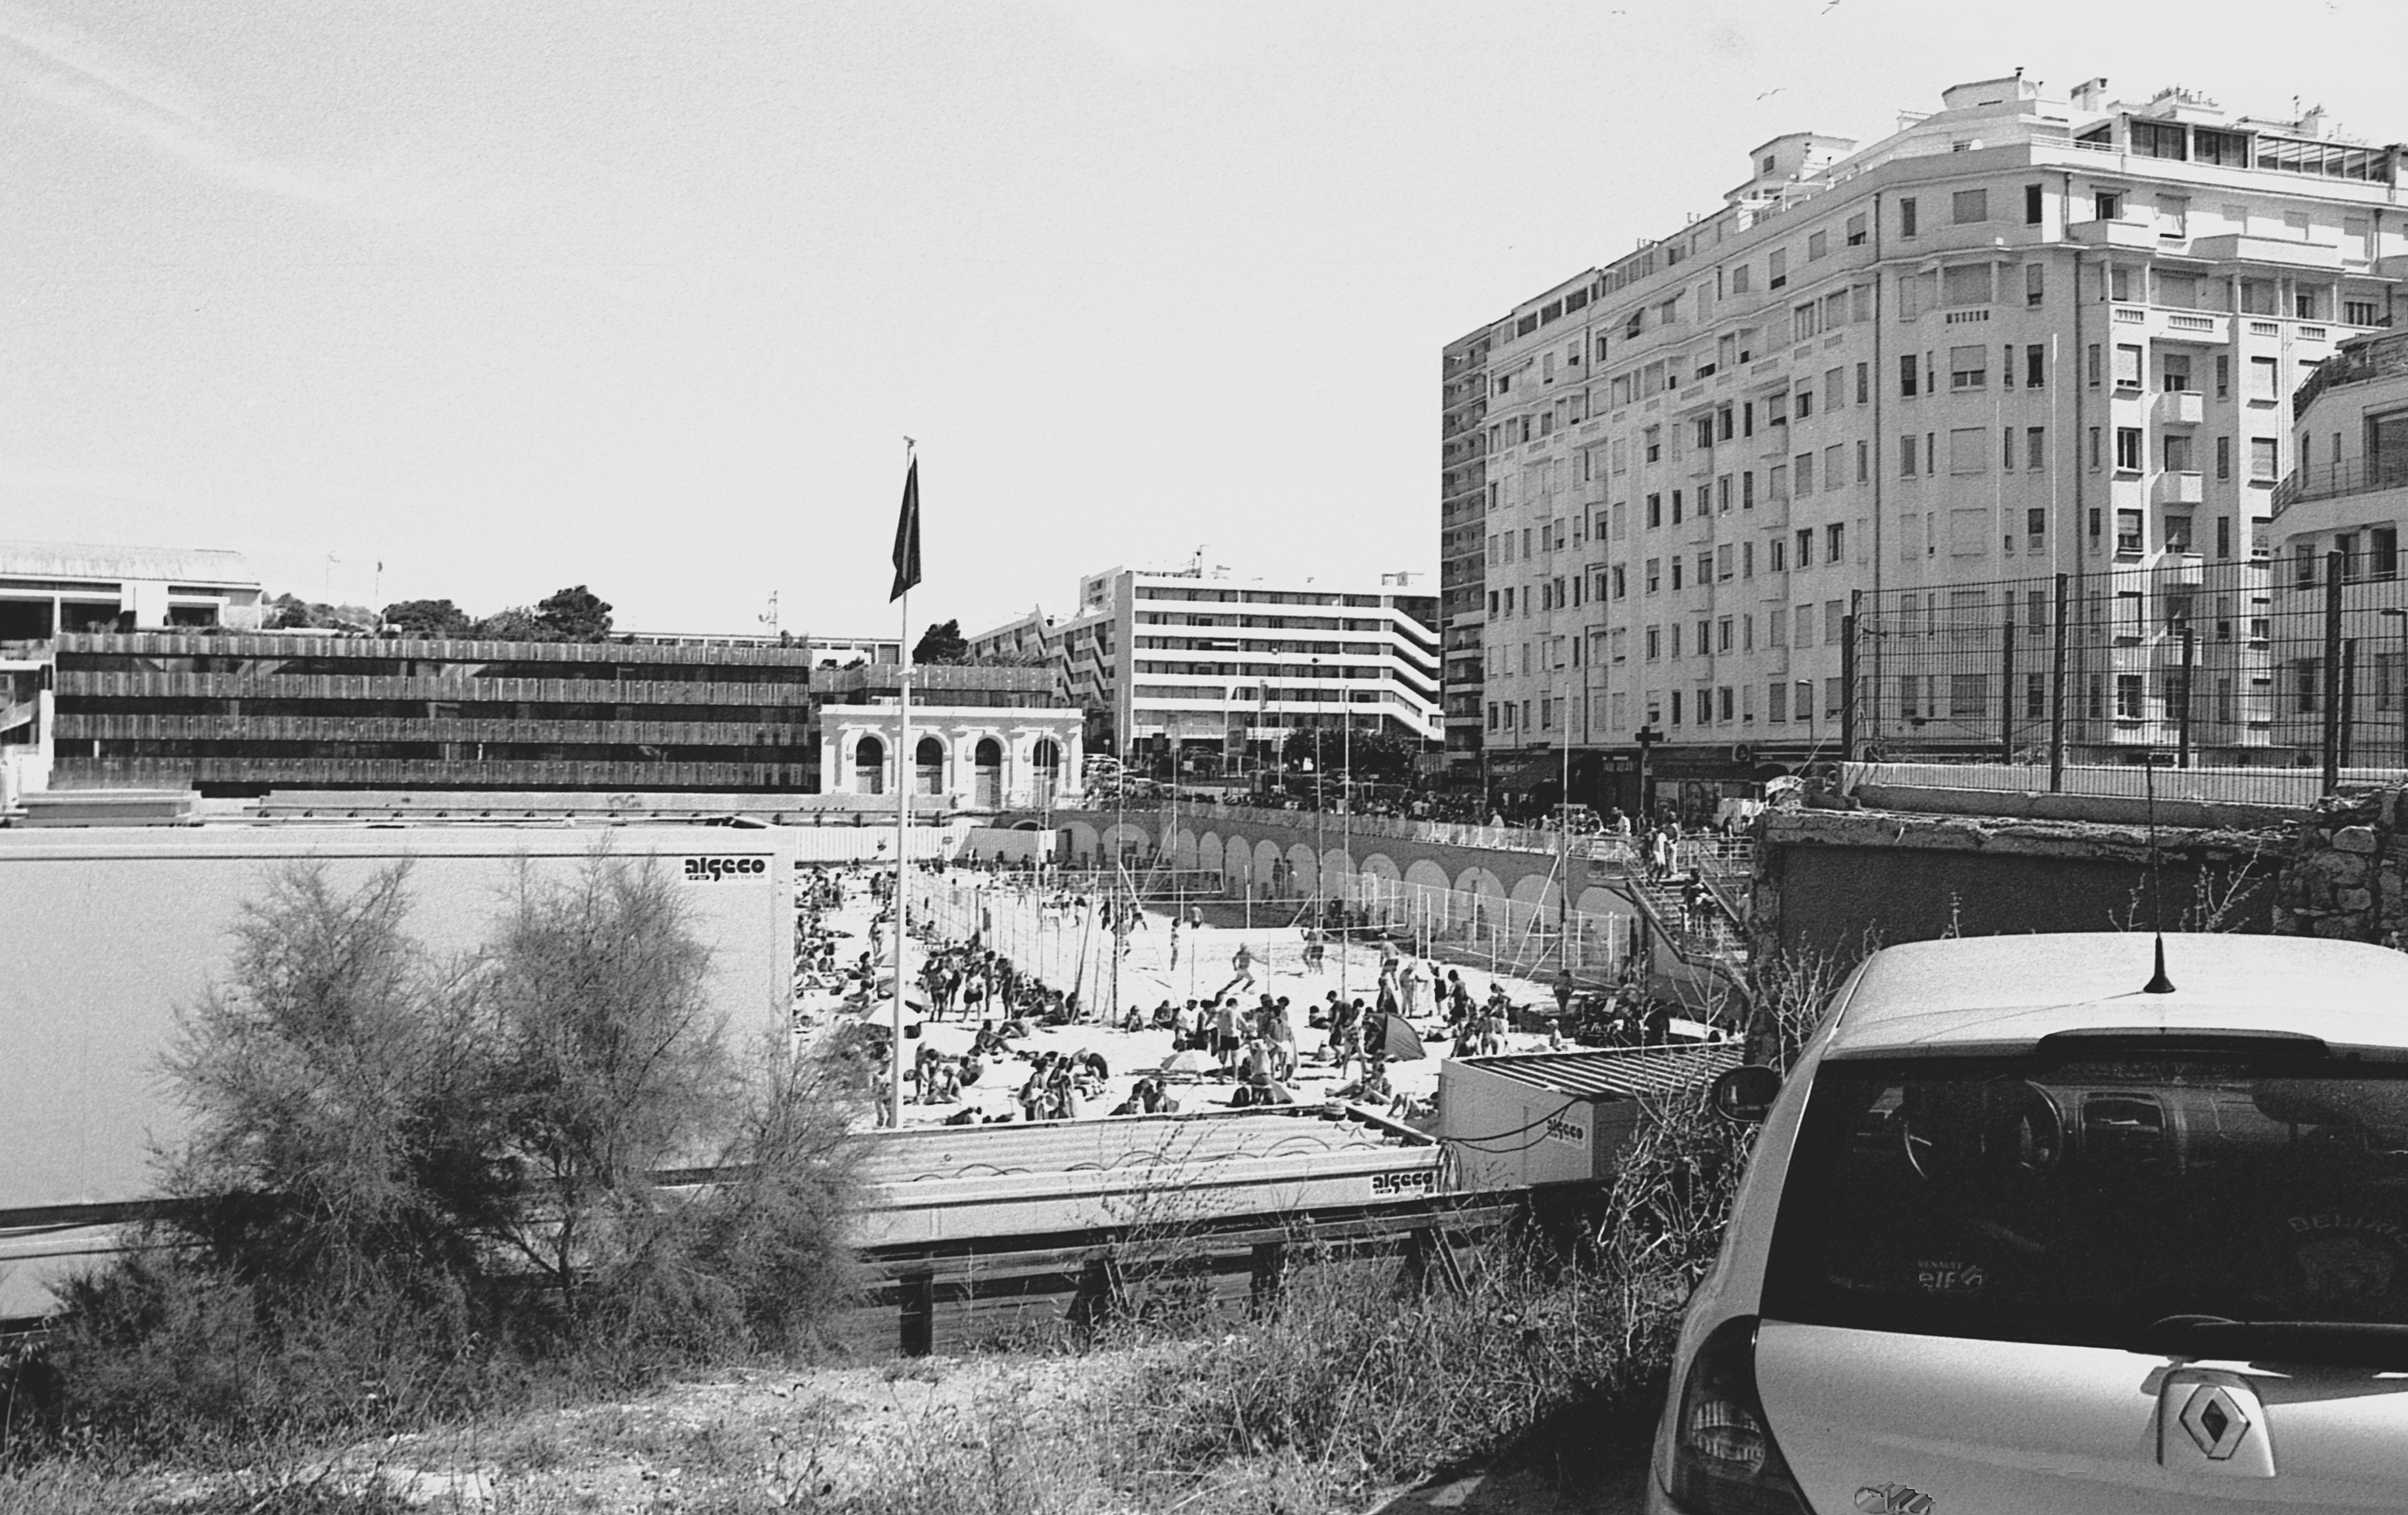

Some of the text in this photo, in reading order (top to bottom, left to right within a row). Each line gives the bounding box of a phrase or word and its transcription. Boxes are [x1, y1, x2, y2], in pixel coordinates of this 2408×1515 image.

[685, 857, 766, 882] algeco
[1372, 1173, 1433, 1194] algeco
[1919, 1270, 1958, 1289] elf
